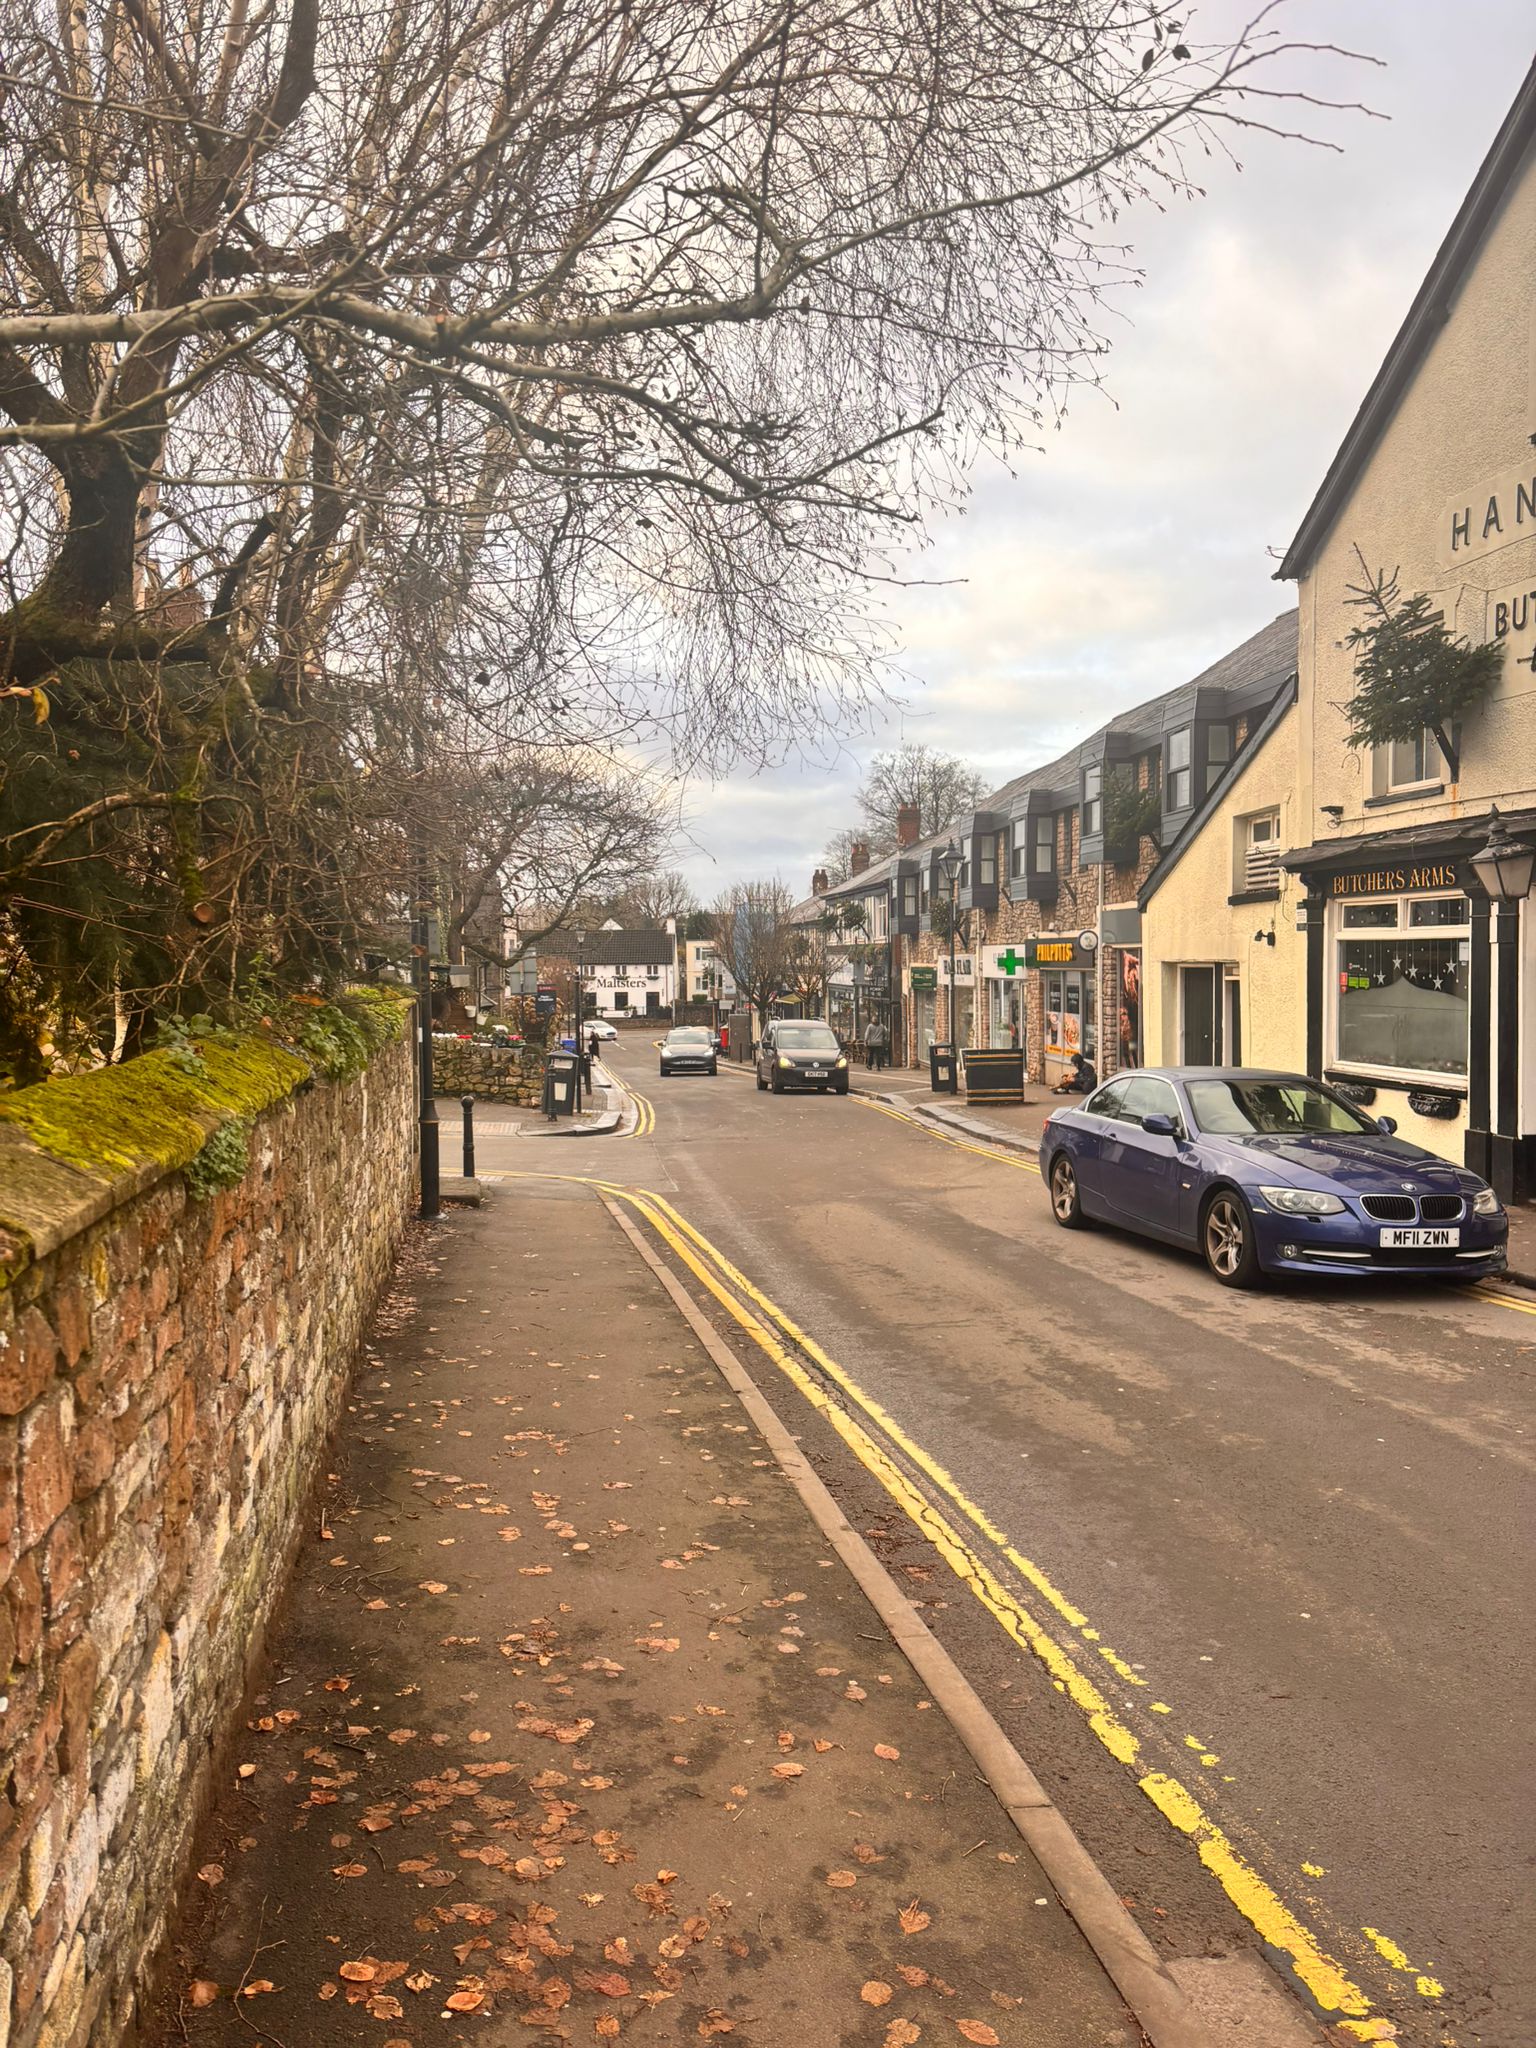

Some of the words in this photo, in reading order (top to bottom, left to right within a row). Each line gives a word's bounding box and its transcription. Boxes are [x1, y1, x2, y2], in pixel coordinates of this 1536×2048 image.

[1333, 869, 1405, 894] BUTCHERS
[1409, 865, 1456, 888] ARMS
[597, 978, 647, 988] Maltsters
[1393, 1230, 1420, 1245] MF11
[1423, 1230, 1449, 1245] ZWN
